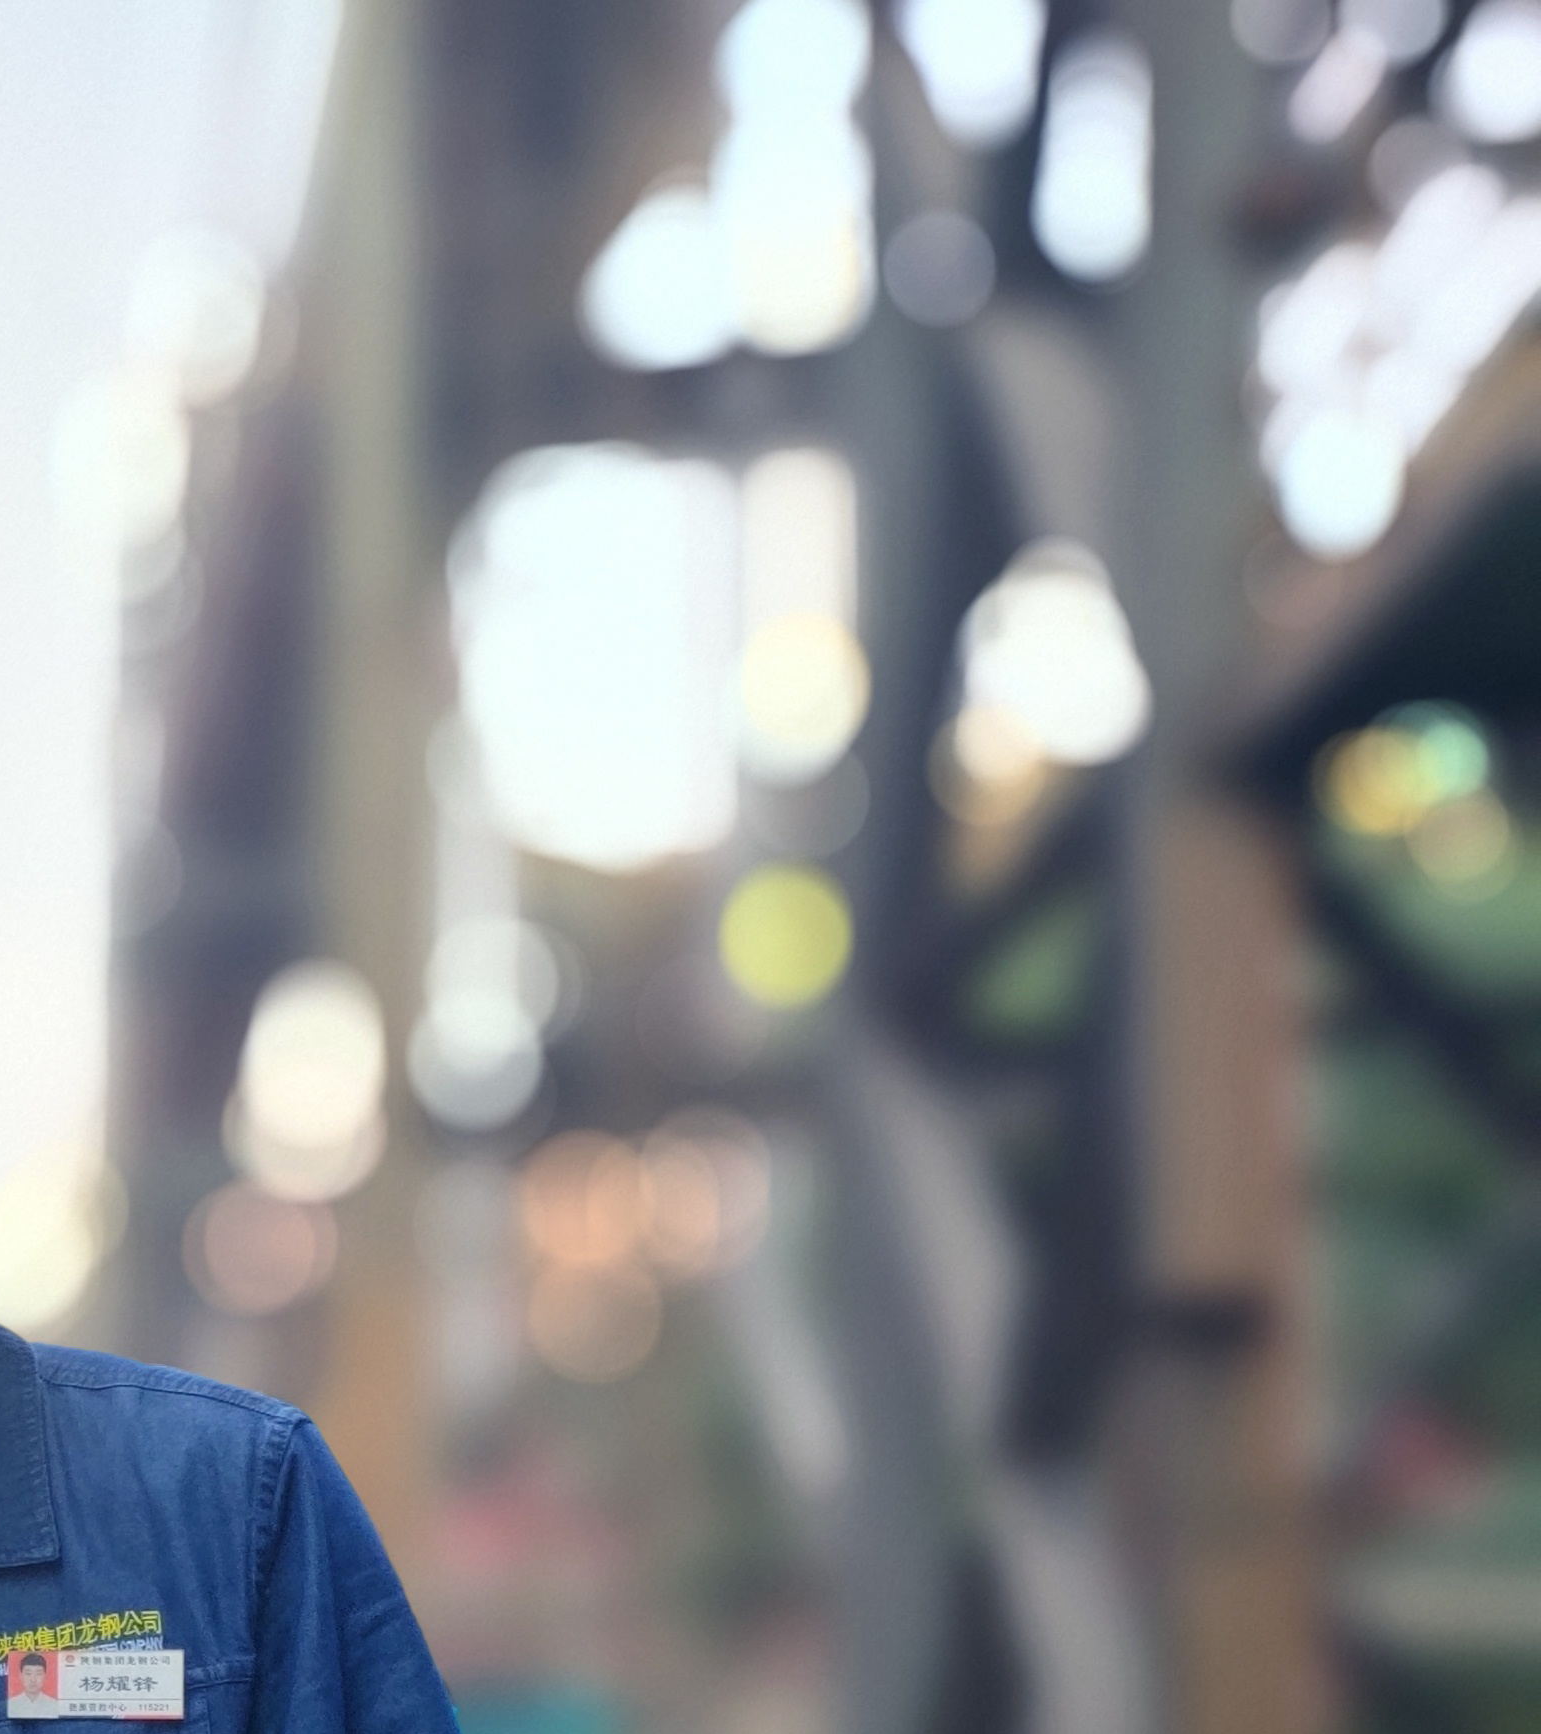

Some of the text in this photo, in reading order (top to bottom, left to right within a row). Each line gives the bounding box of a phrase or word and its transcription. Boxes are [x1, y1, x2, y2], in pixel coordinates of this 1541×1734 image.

[78, 1675, 159, 1693] 杨耀锋
[139, 1703, 171, 1713] 115221
